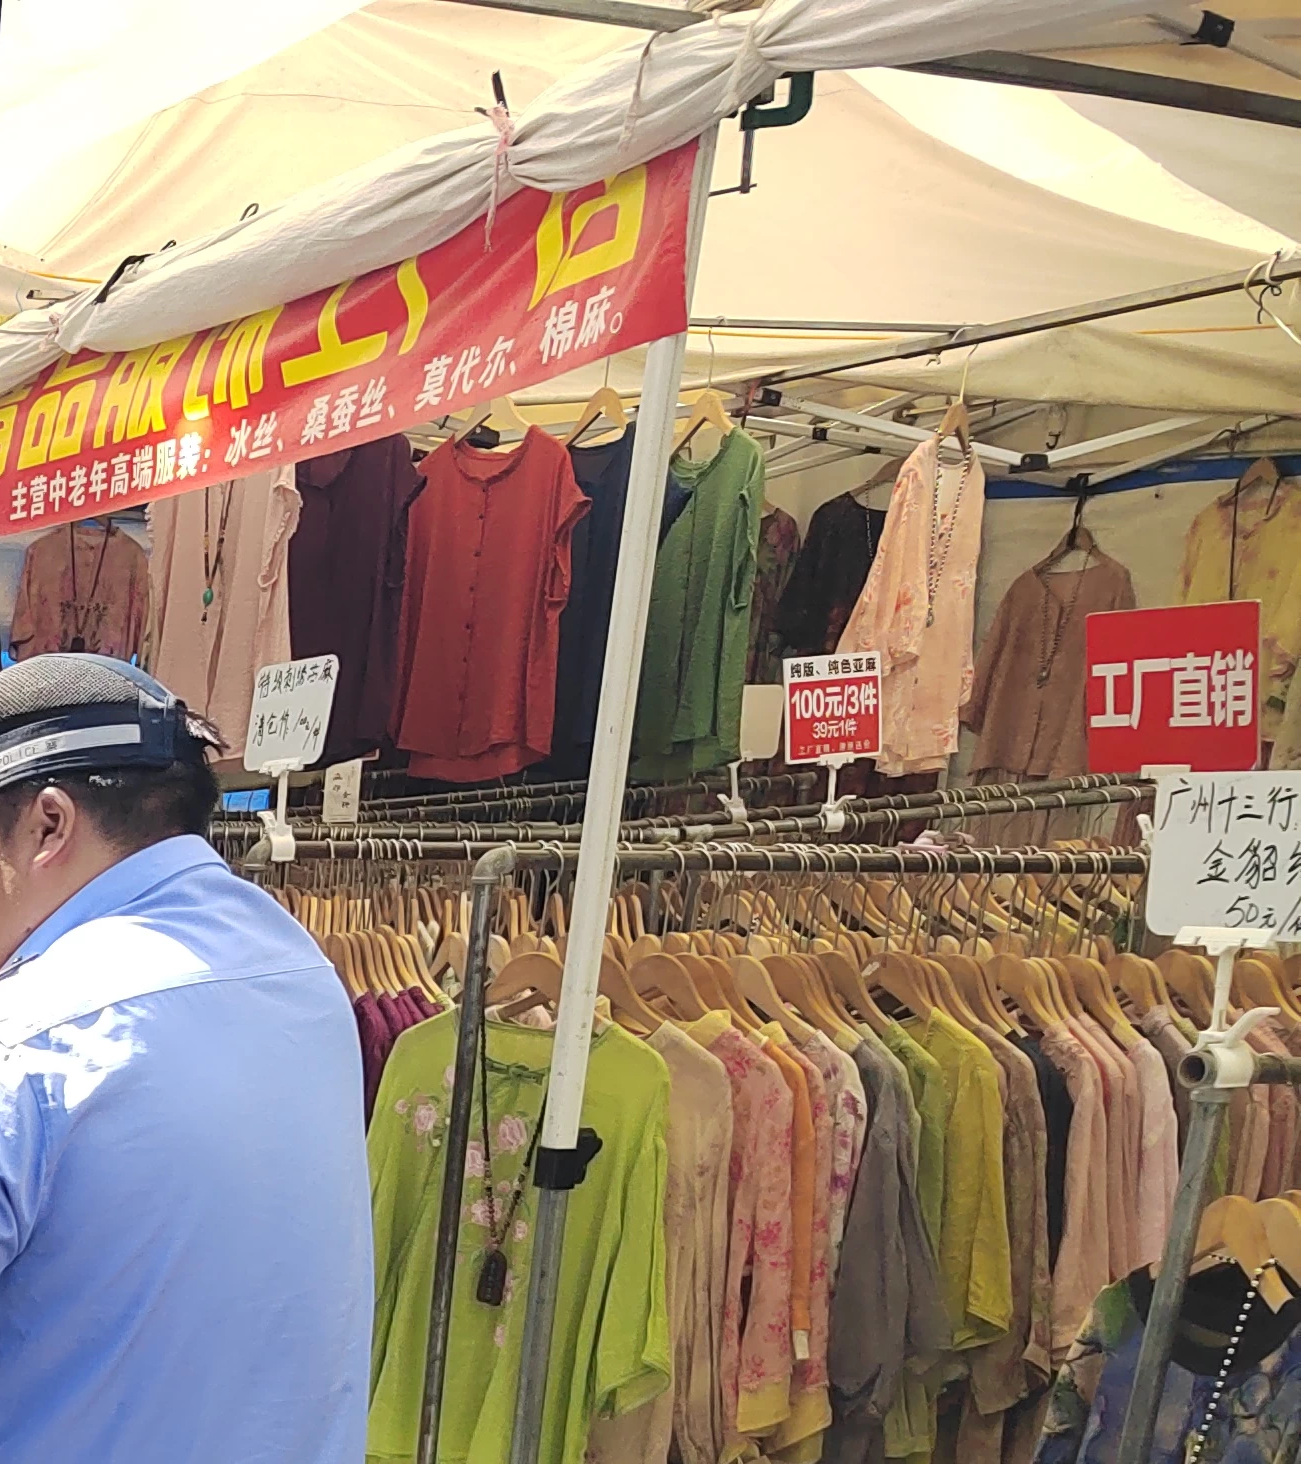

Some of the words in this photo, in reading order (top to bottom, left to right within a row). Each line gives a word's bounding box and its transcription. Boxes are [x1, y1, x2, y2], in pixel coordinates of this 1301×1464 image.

[791, 681, 878, 720] 100元/3件
[1090, 649, 1255, 730] 工厂直销
[812, 718, 858, 739] 39元1件
[1160, 777, 1299, 834] 广州十三行
